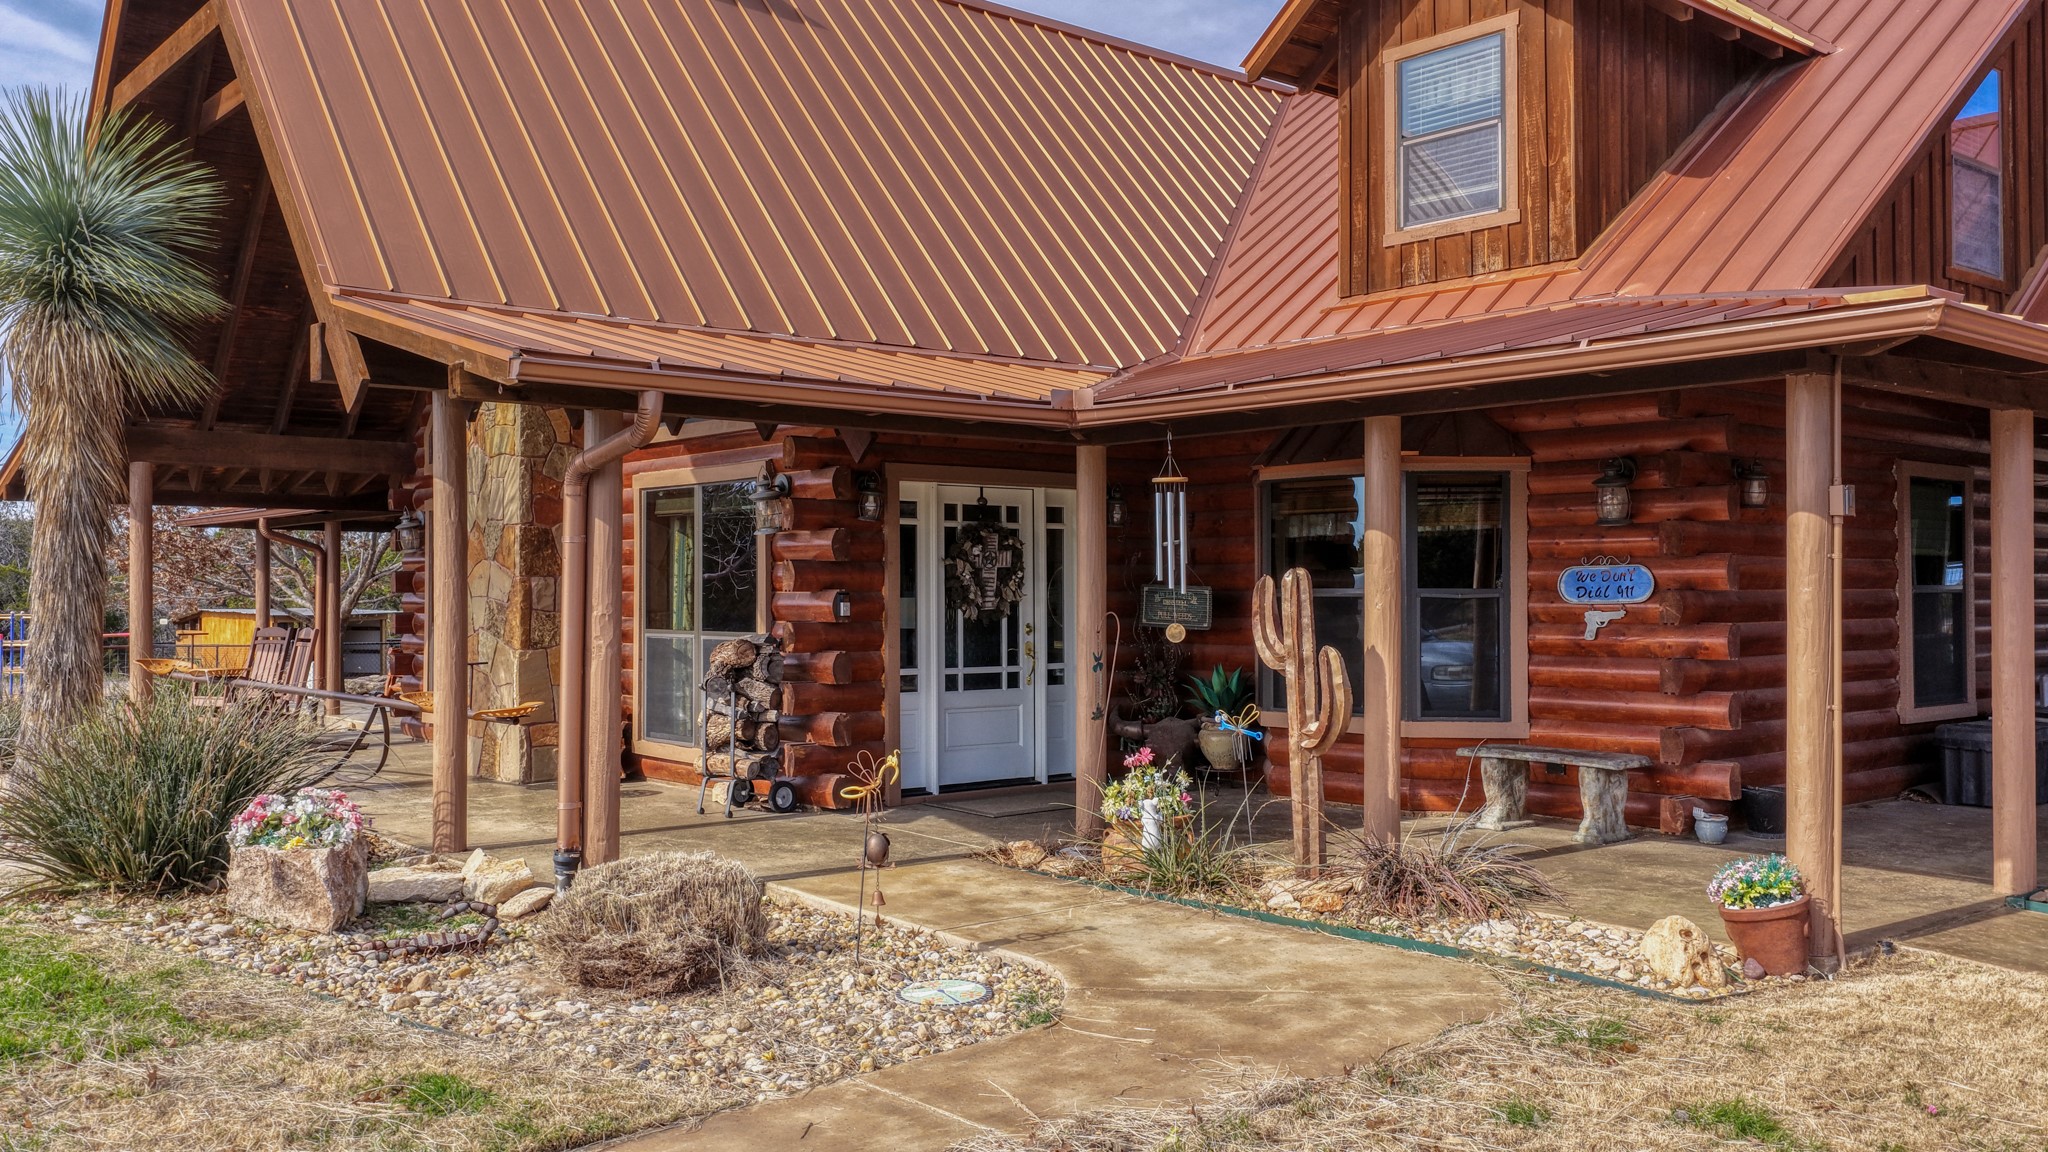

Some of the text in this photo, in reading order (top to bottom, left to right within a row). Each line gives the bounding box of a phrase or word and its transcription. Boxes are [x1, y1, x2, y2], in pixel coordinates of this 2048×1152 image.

[1575, 570, 1597, 582] We
[1576, 585, 1634, 598] Dial 911
